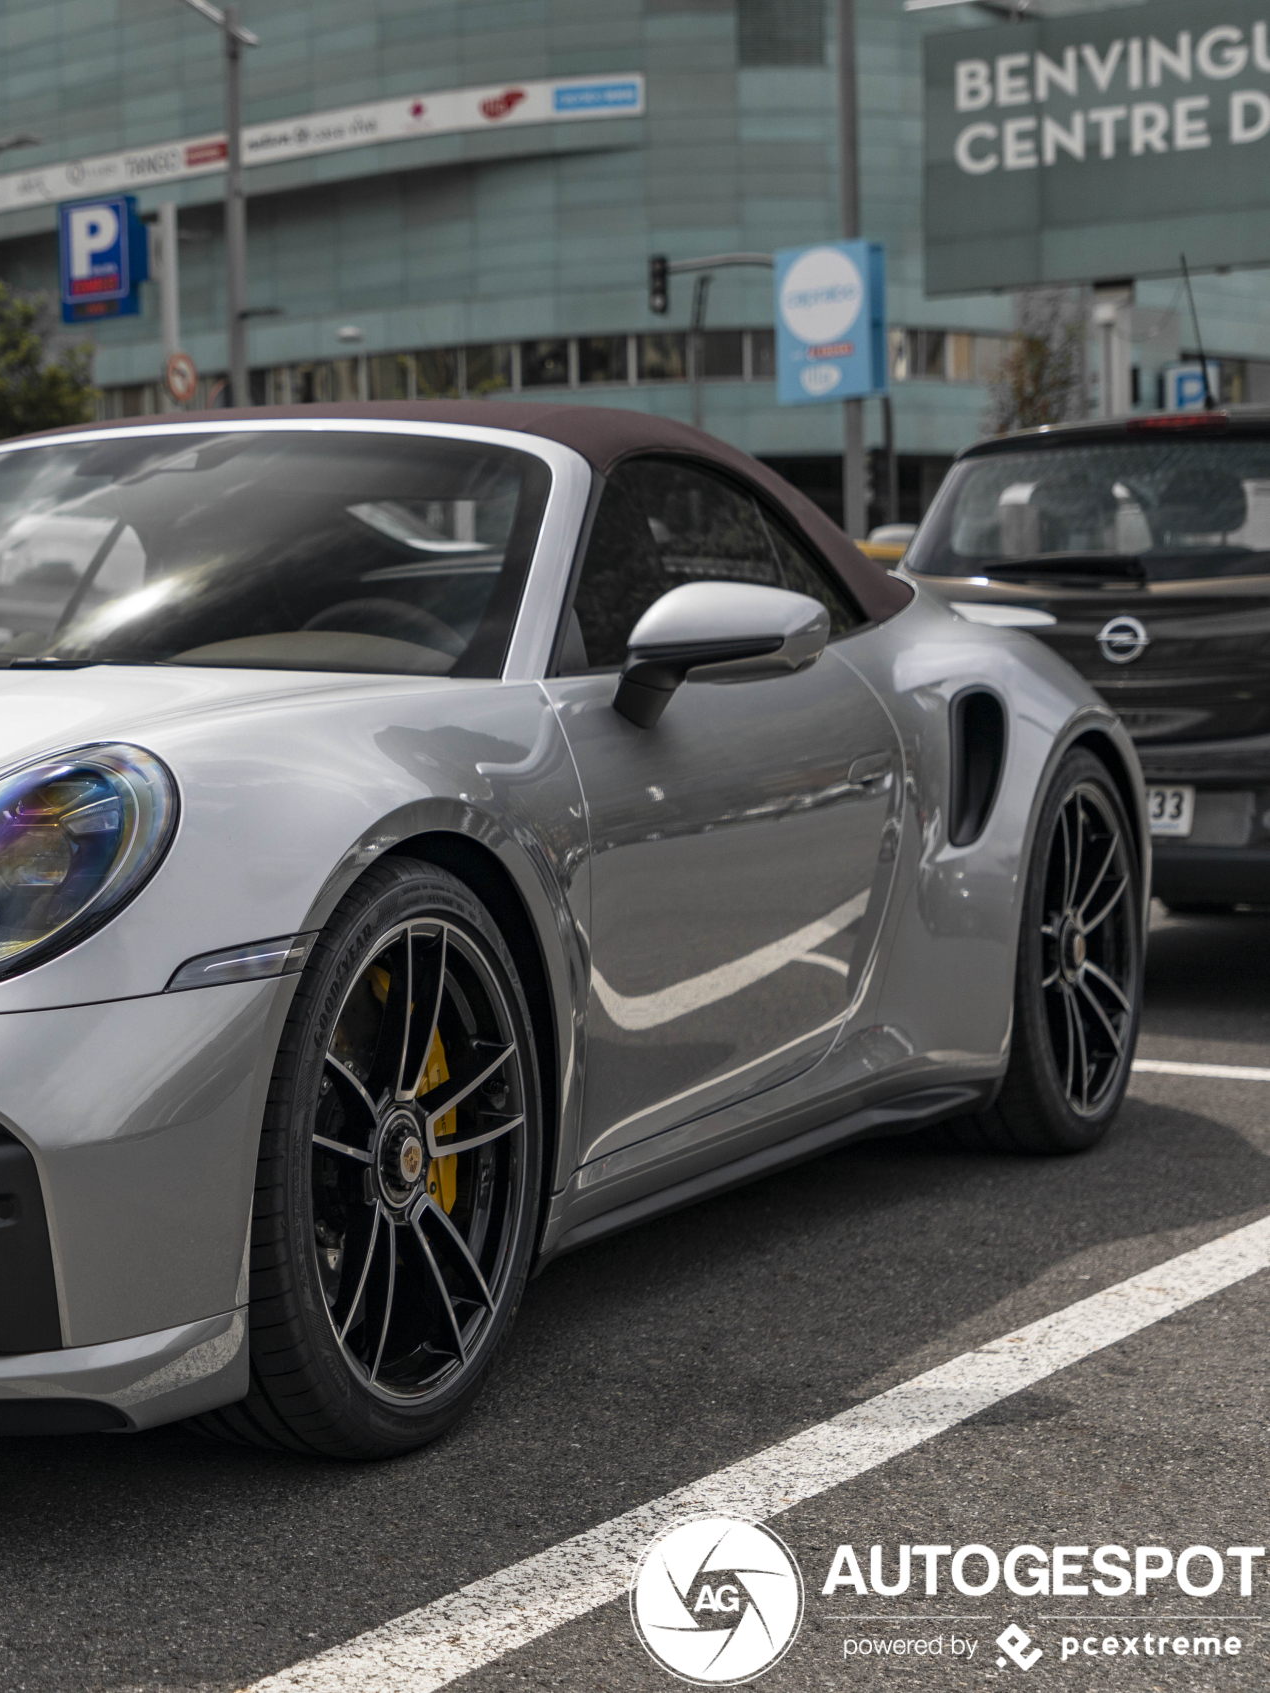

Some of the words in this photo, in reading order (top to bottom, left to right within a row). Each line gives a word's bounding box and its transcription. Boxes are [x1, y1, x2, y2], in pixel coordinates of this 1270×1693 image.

[955, 95, 1211, 175] CENTRE
[70, 205, 118, 278] P
[1177, 372, 1207, 409] P
[1146, 791, 1184, 820] 33
[314, 923, 374, 1049] GOODYEAR
